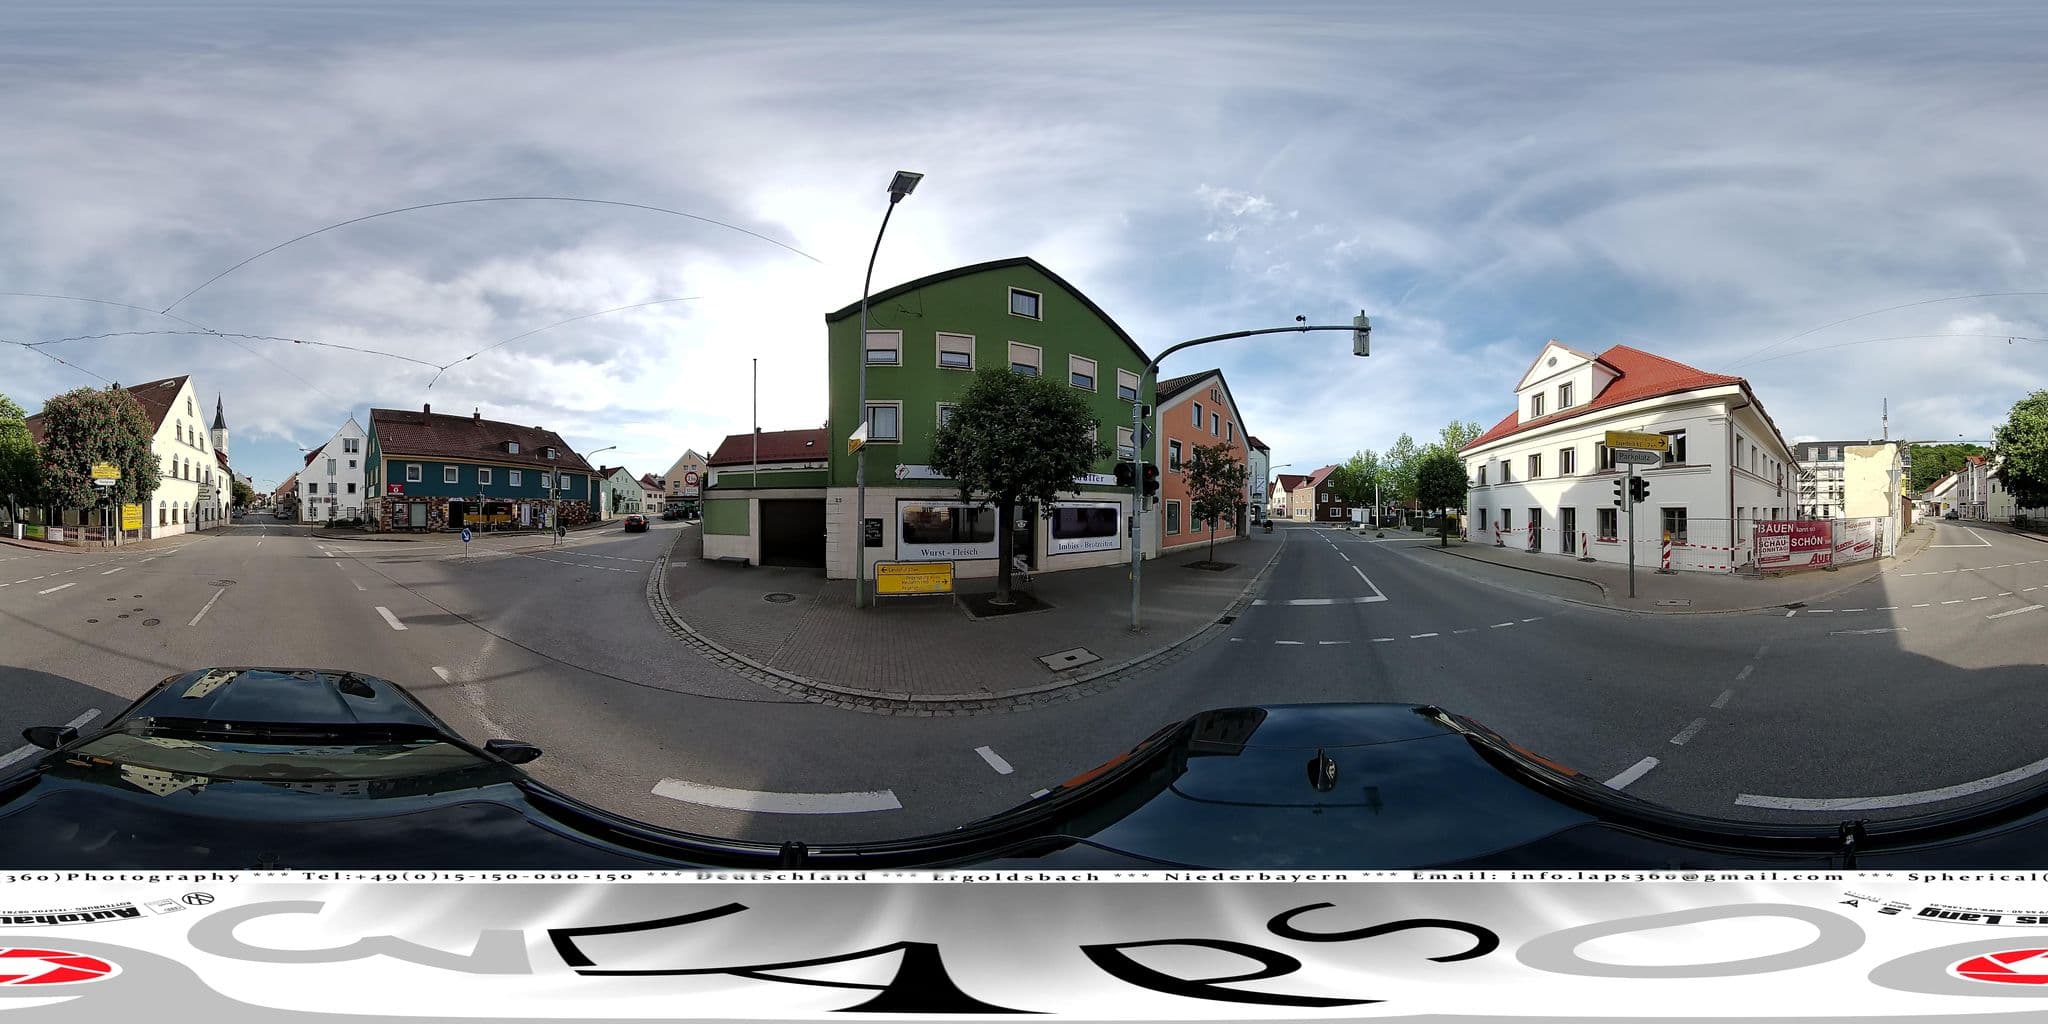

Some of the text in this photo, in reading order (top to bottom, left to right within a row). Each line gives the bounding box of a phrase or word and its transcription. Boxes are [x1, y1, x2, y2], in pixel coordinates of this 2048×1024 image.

[1619, 453, 1650, 461] Parkplatz
[1758, 523, 1794, 533] BAUEN
[1791, 534, 1823, 546] SCHÖN
[1058, 543, 1079, 551] Imbiss
[920, 549, 945, 557] Wurst
[952, 548, 978, 556] Fleisch
